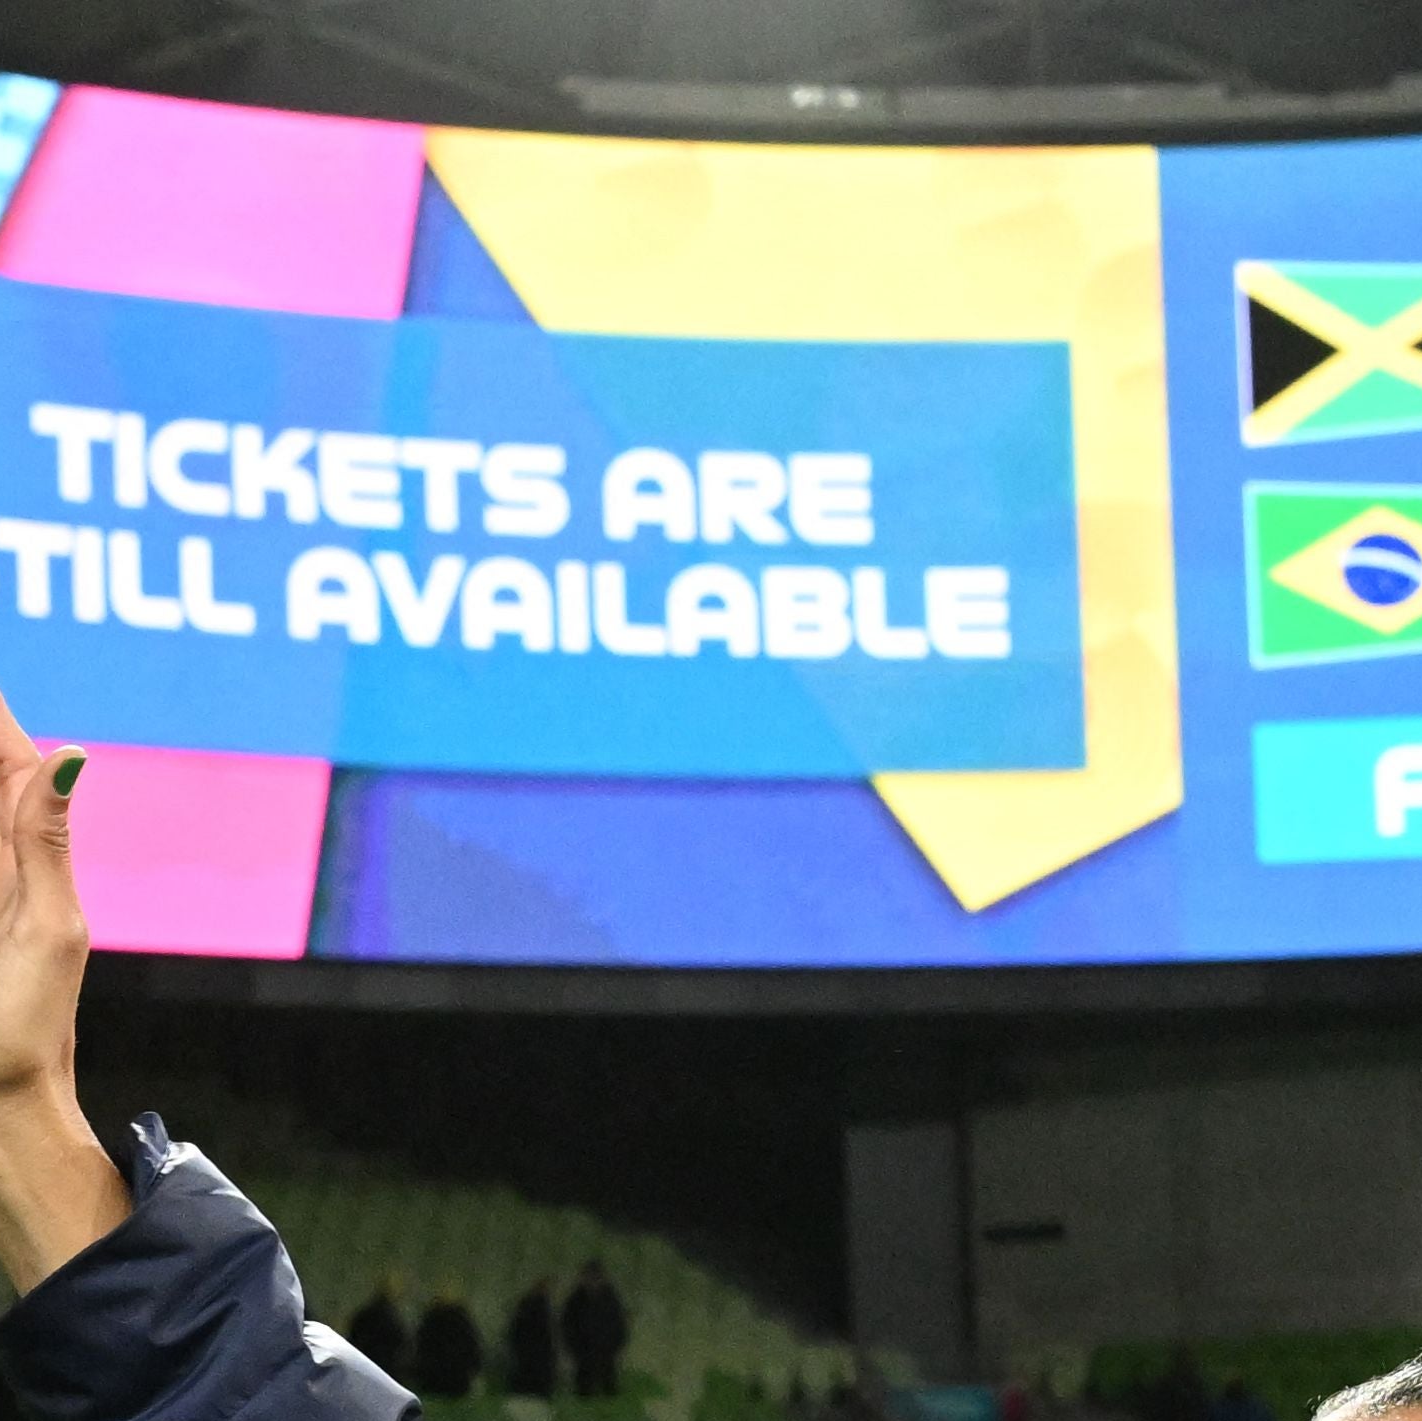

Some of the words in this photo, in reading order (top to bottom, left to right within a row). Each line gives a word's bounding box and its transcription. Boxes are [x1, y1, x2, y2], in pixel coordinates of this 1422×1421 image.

[29, 403, 570, 537] TICKETS
[603, 448, 874, 545] ARE
[286, 547, 1012, 659] AVAILABLE
